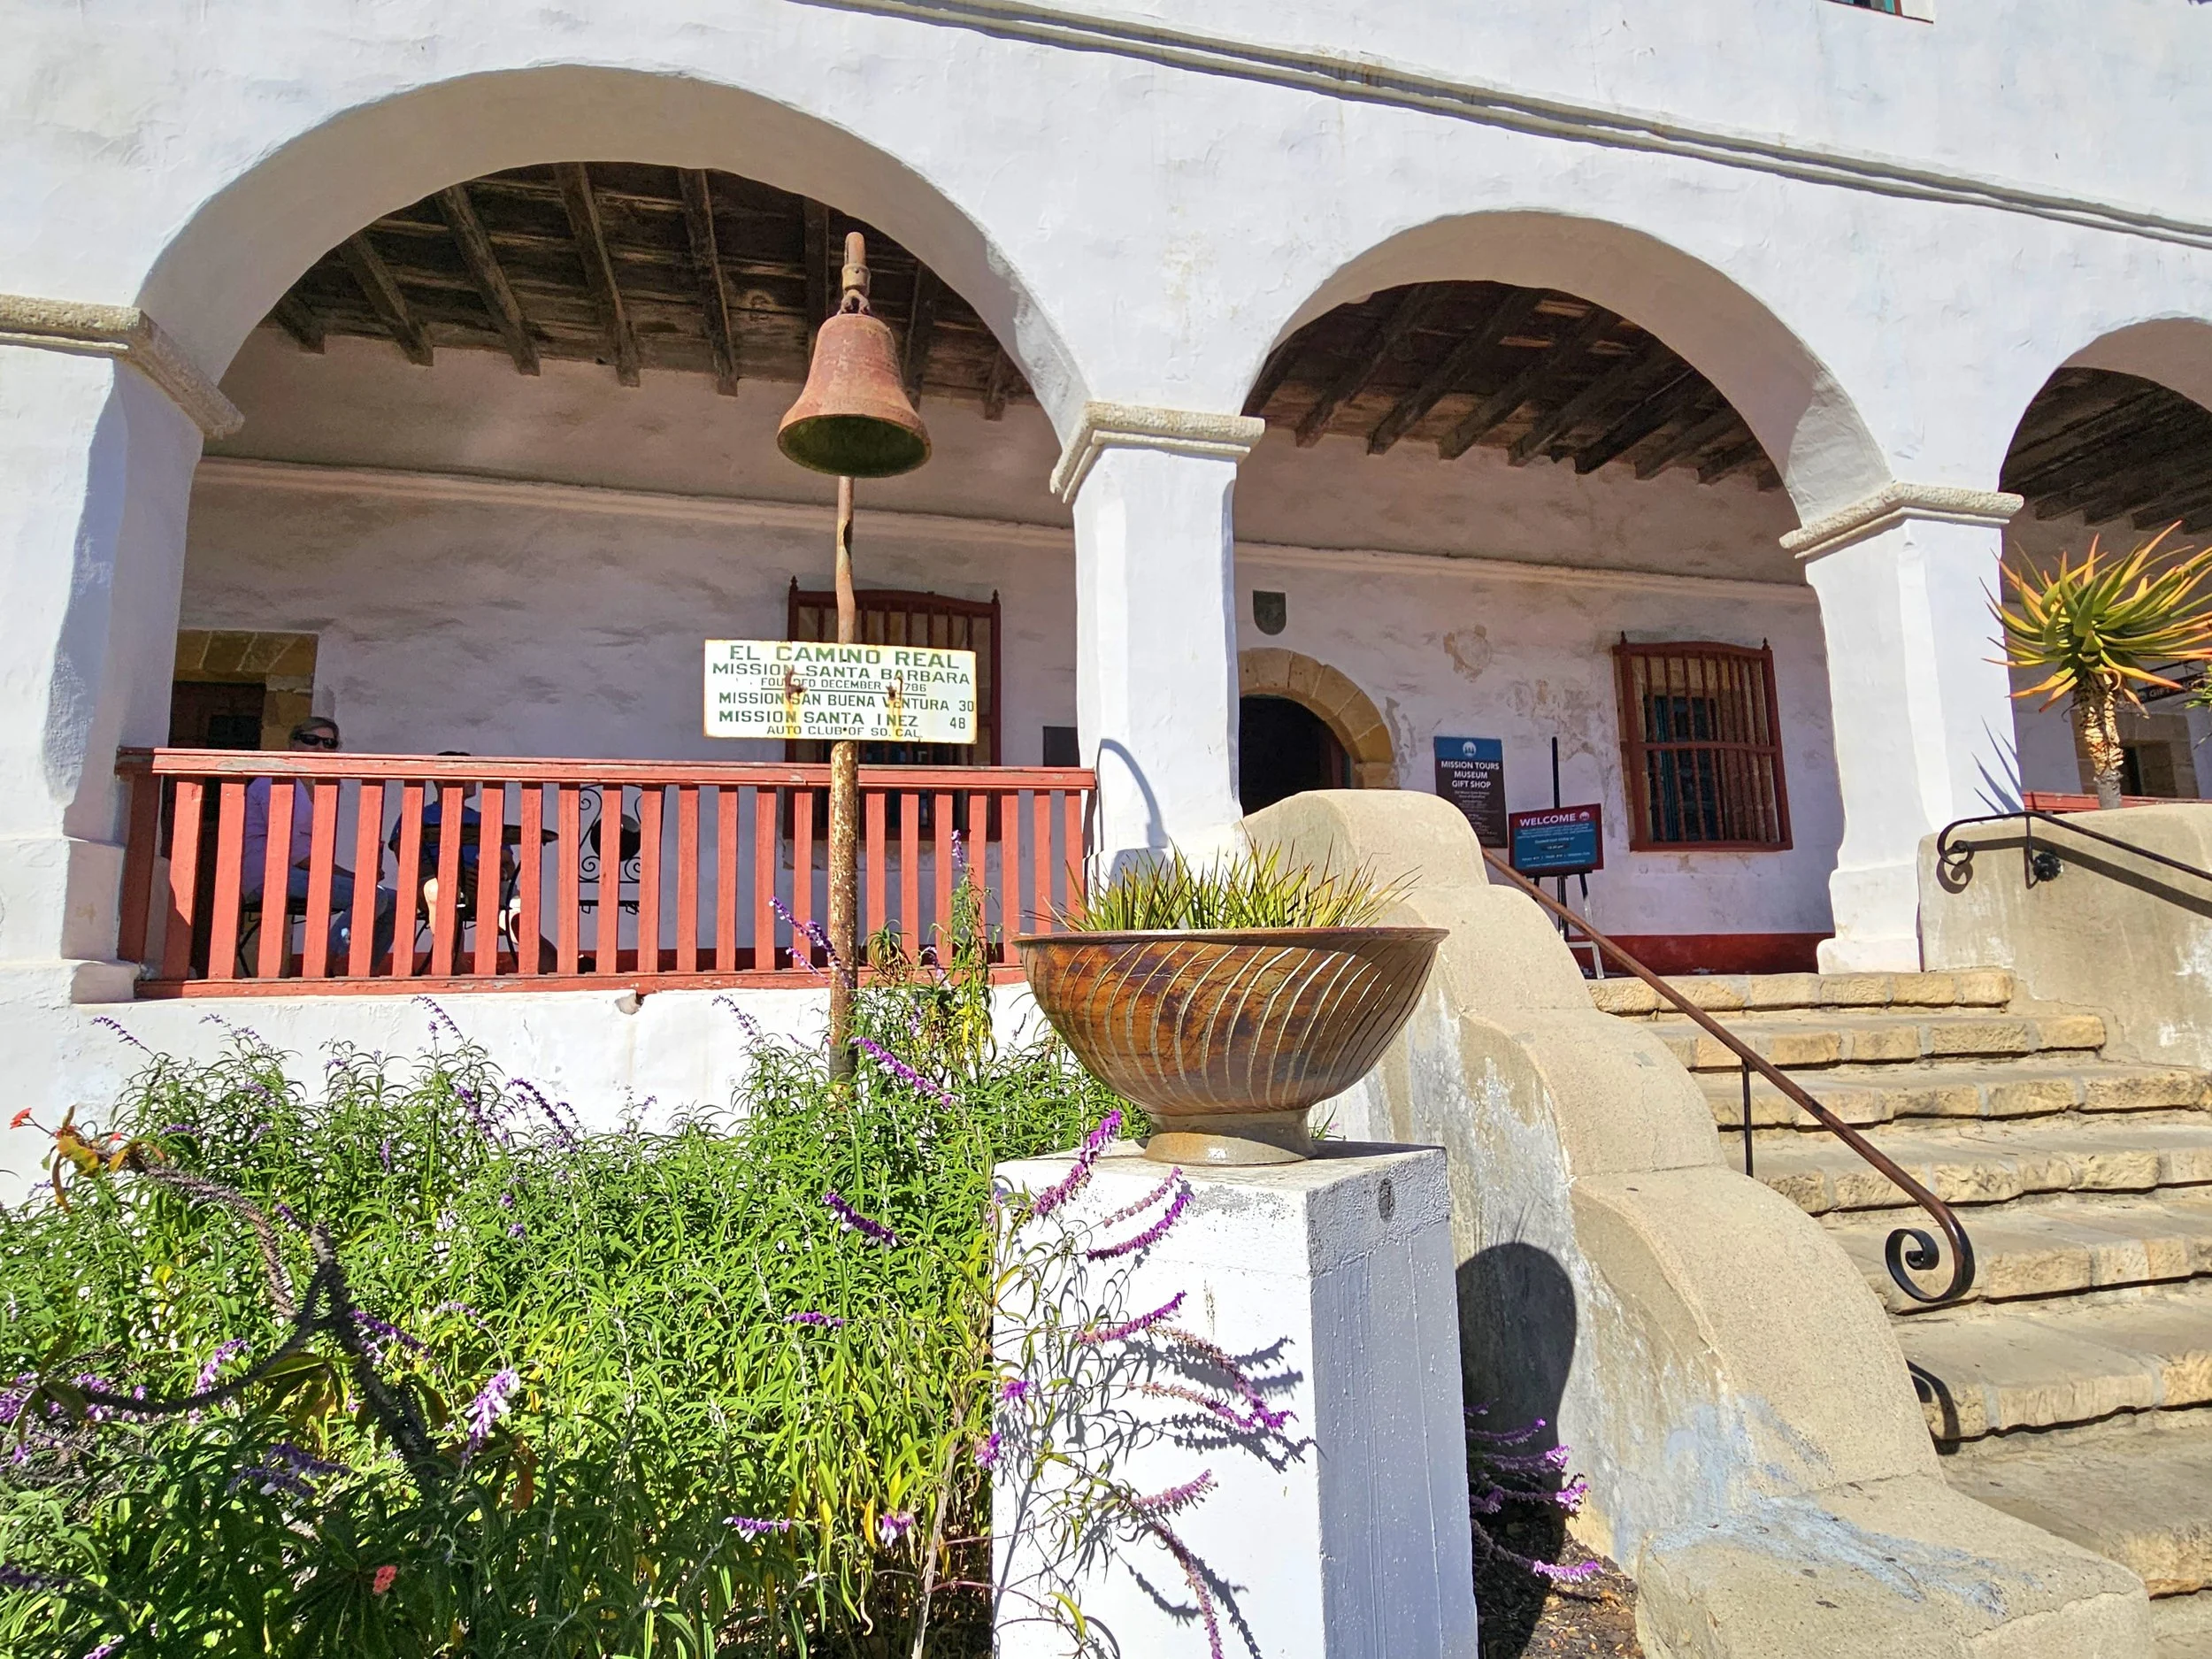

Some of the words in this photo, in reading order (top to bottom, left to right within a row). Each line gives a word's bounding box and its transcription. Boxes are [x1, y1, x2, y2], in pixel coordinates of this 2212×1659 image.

[730, 645, 761, 660] EL
[776, 646, 881, 664] CAMINO
[895, 650, 960, 669] REAL
[712, 663, 795, 676] MISSION
[806, 665, 871, 679] SANTA
[880, 669, 971, 685] BARBARA
[821, 679, 881, 690] DECEMBER
[719, 692, 784, 704] MISSION
[792, 694, 821, 705] SAN
[828, 694, 876, 708] BUENA
[958, 700, 975, 712] 30
[719, 710, 796, 723] MISSION
[803, 711, 864, 725] SANTA
[949, 717, 966, 729] 48
[767, 726, 802, 734] AUTO
[808, 726, 842, 735] CLUB
[848, 726, 864, 736] OF
[1440, 761, 1473, 770] MISSION
[1475, 762, 1500, 771] TOURS
[1454, 771, 1488, 780] MUSEUM
[1451, 780, 1469, 788] GIFT
[1470, 780, 1492, 789] SHOP
[1519, 812, 1577, 827] WELCOME
